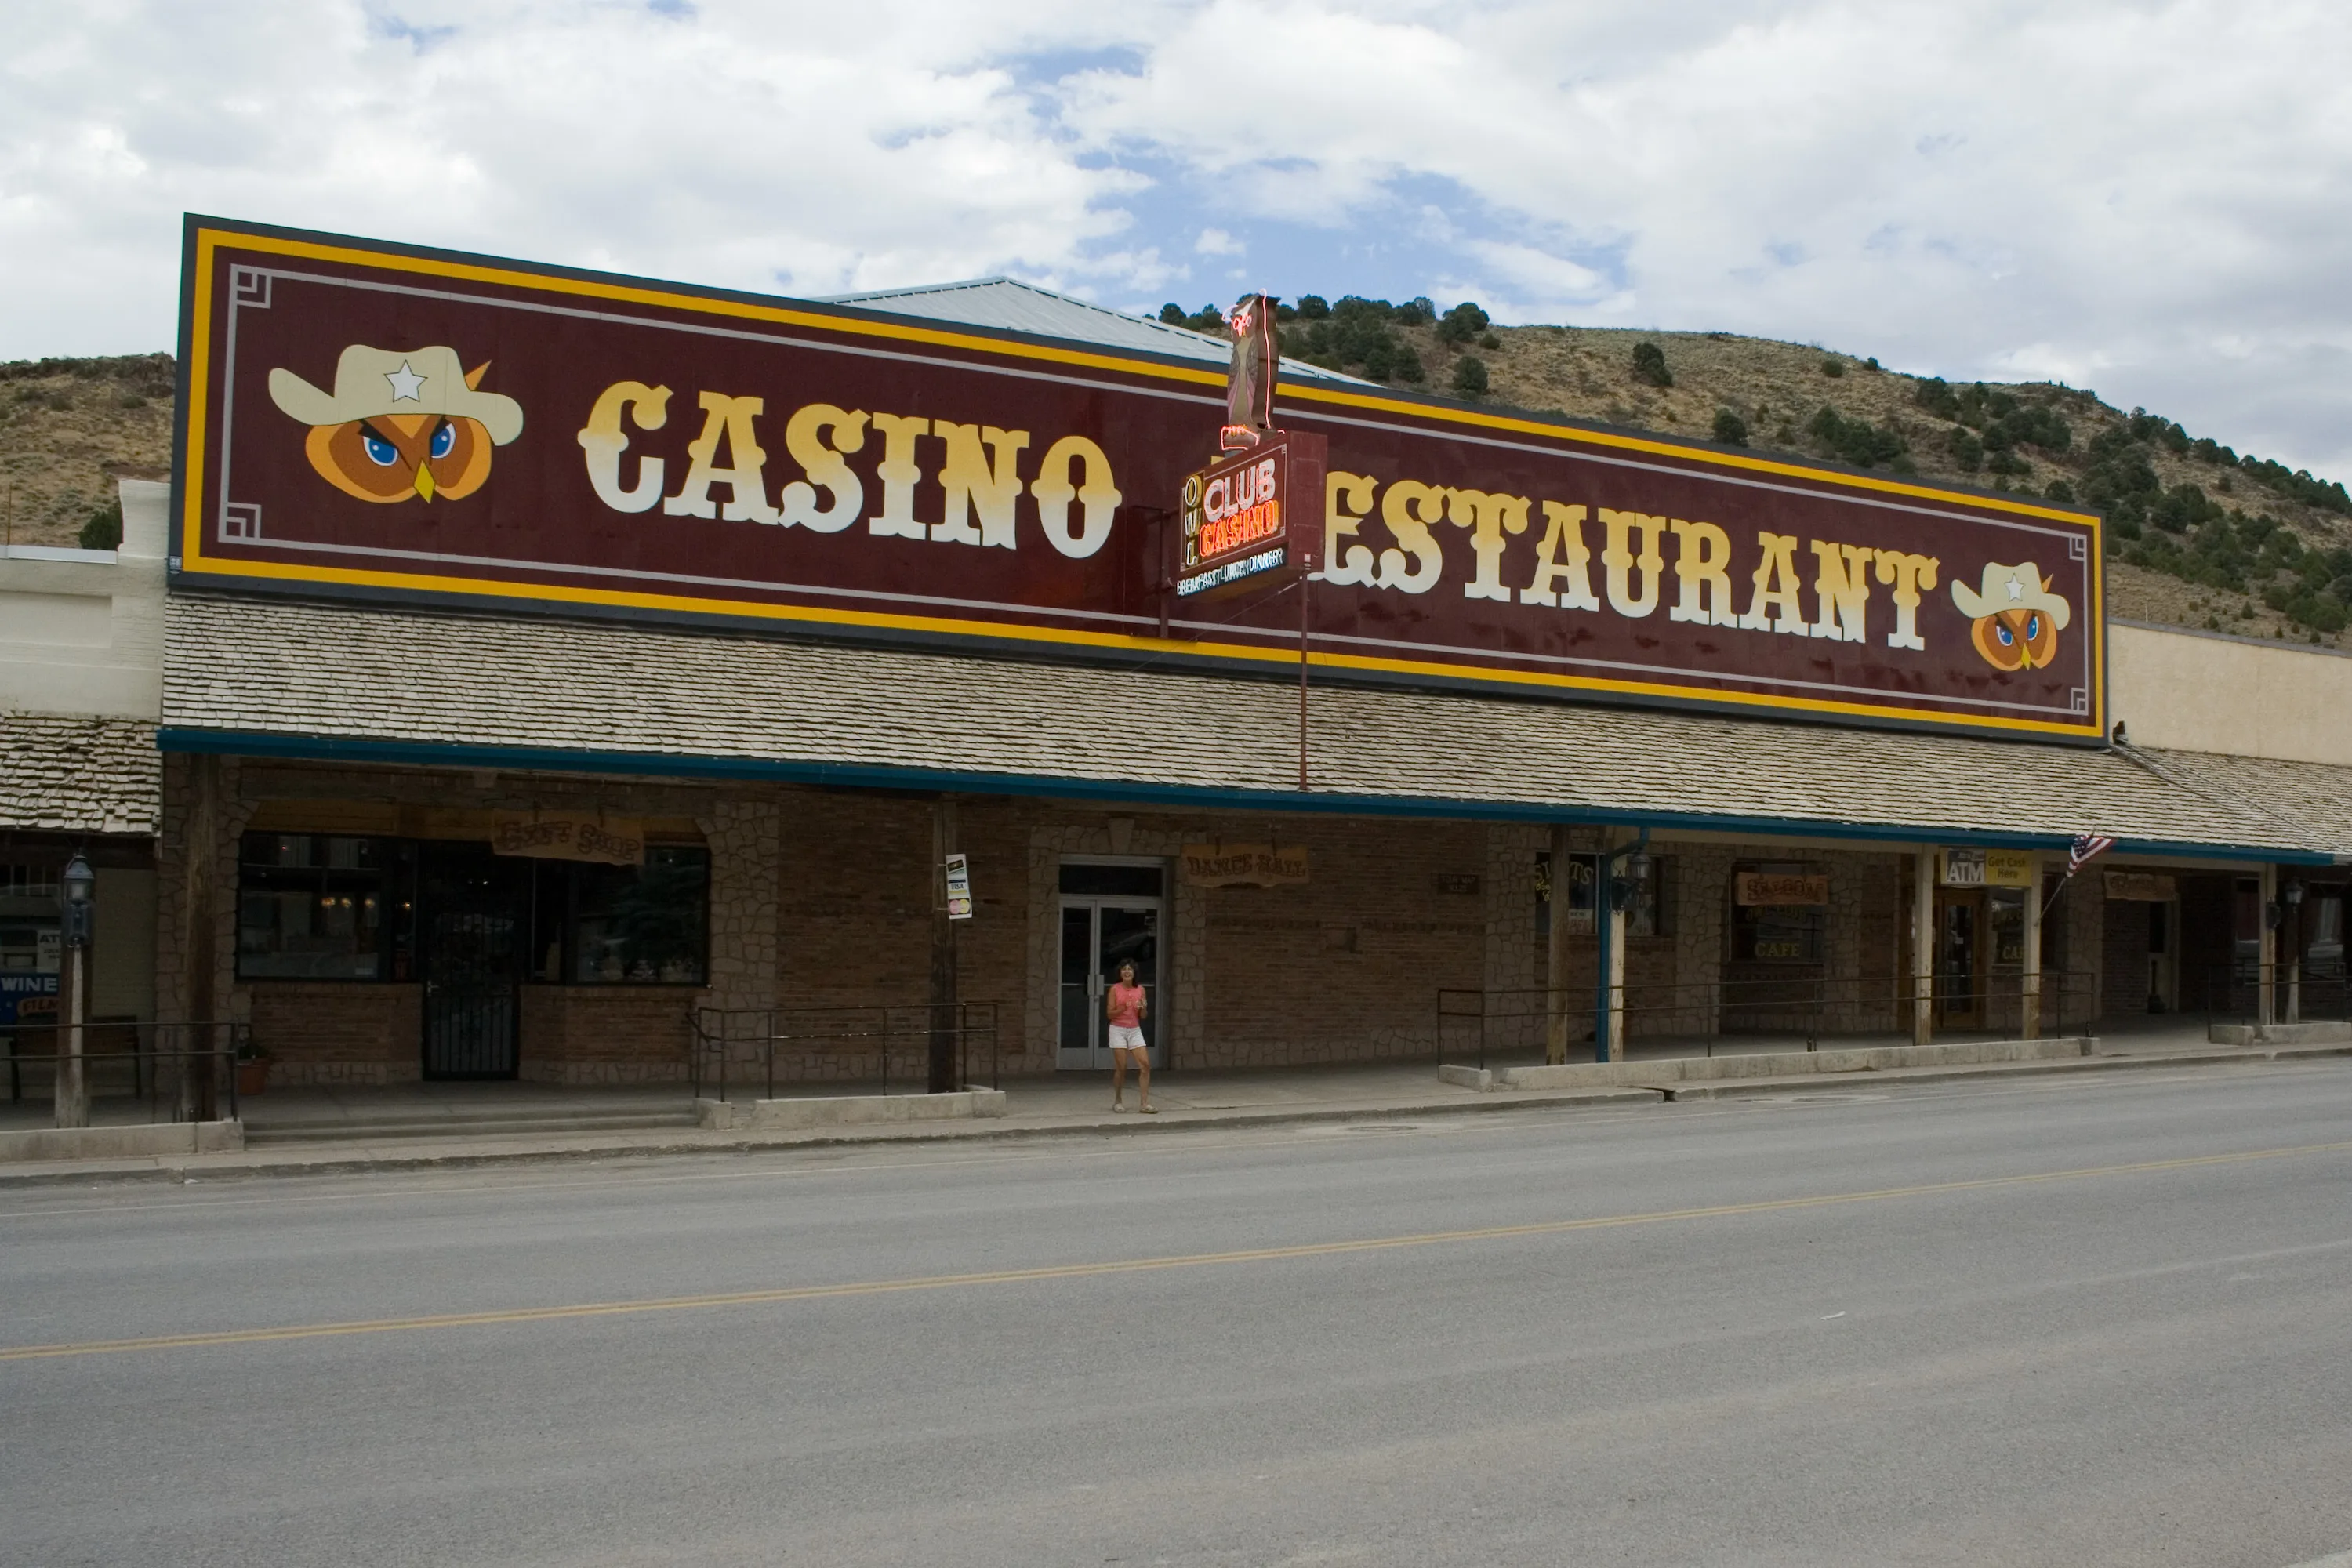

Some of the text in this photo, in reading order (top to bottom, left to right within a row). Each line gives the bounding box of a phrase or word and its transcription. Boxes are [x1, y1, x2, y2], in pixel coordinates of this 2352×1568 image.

[1203, 458, 1276, 522] CLUB
[577, 381, 1940, 651] CASINO ESTAURANT
[1185, 475, 1203, 566] OWL
[1200, 499, 1279, 557] CASINO
[1249, 547, 1283, 573] DINNER
[577, 823, 641, 860] SHOP
[1187, 853, 1305, 877] DANCE HALL
[1946, 861, 1985, 883] ATM
[1988, 856, 2005, 866] Get
[1998, 868, 2019, 878] Here
[1747, 879, 1824, 902] SALOON
[1755, 941, 1801, 958] CAFE
[1, 977, 58, 993] WINE
